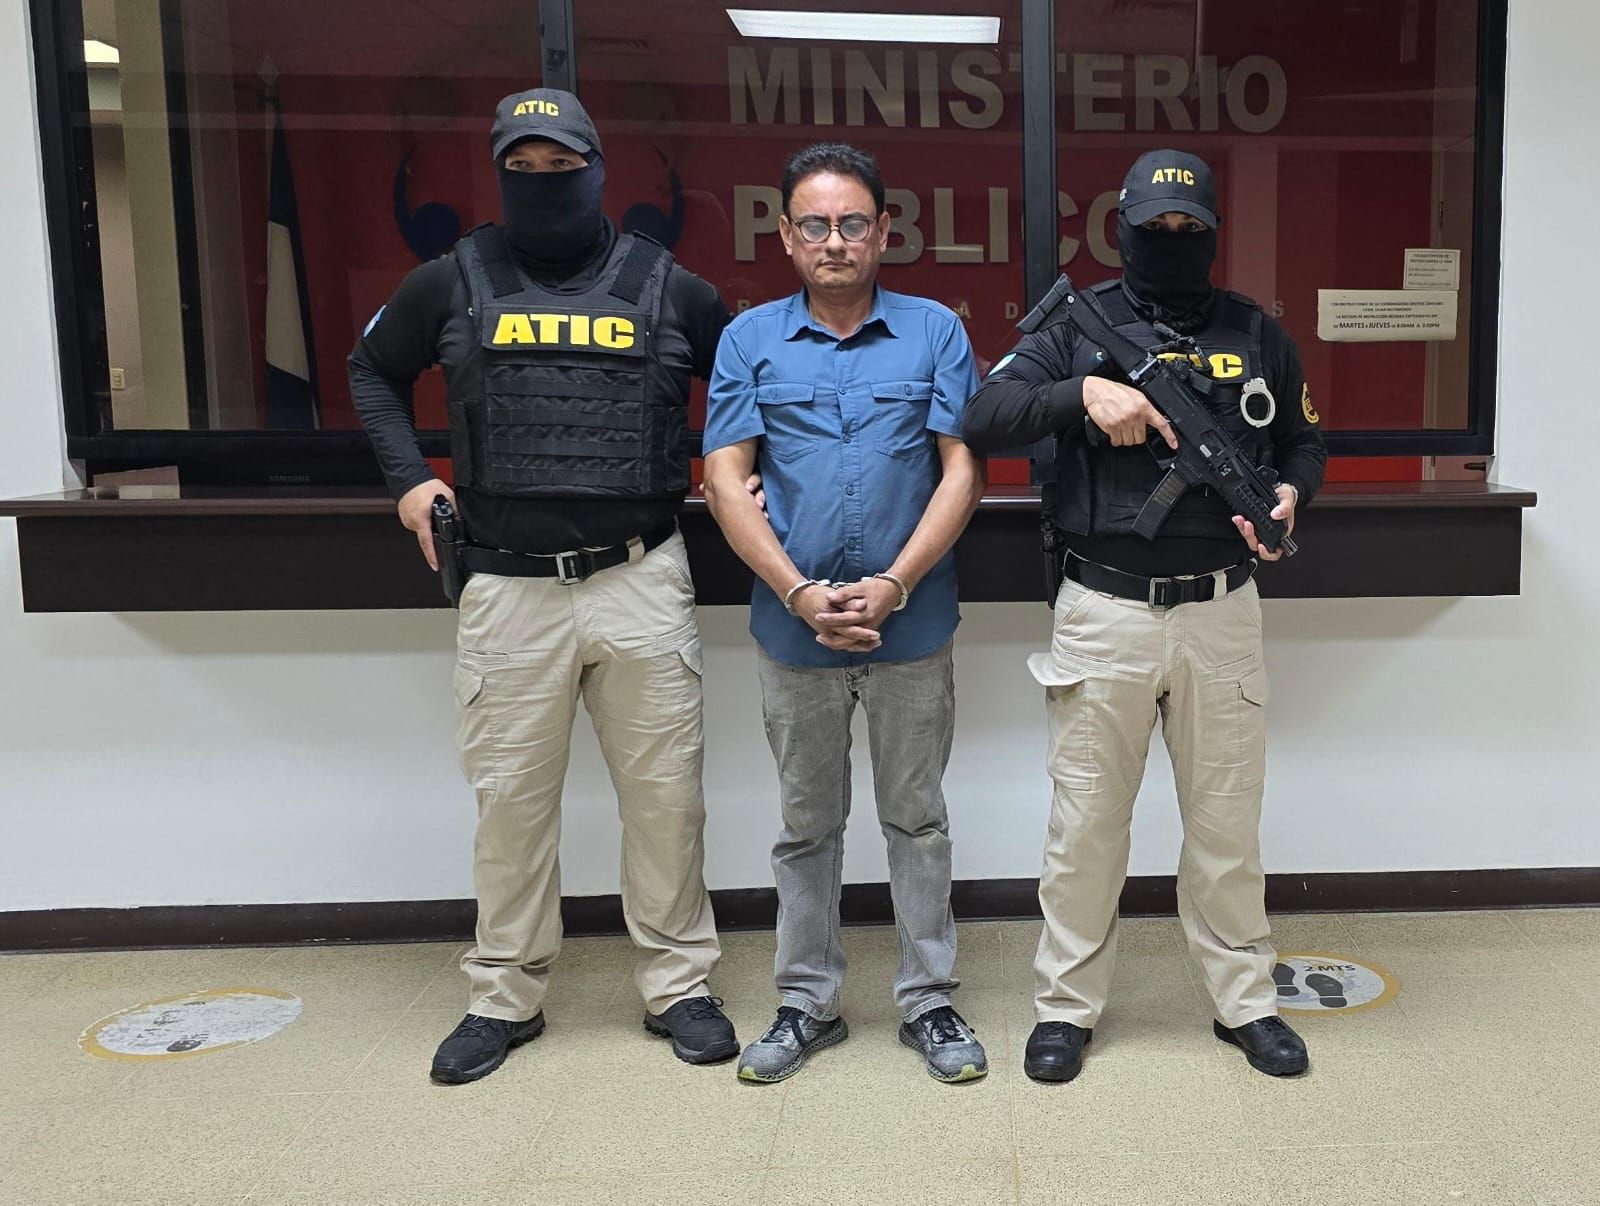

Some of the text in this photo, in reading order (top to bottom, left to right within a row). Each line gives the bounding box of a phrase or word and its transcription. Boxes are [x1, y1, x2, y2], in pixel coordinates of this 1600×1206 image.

[728, 46, 1288, 134] MINISERIO
[513, 100, 560, 117] ATIC
[1151, 168, 1196, 187] ATIC
[492, 313, 637, 349] ATIC
[1317, 964, 1356, 972] MTS
